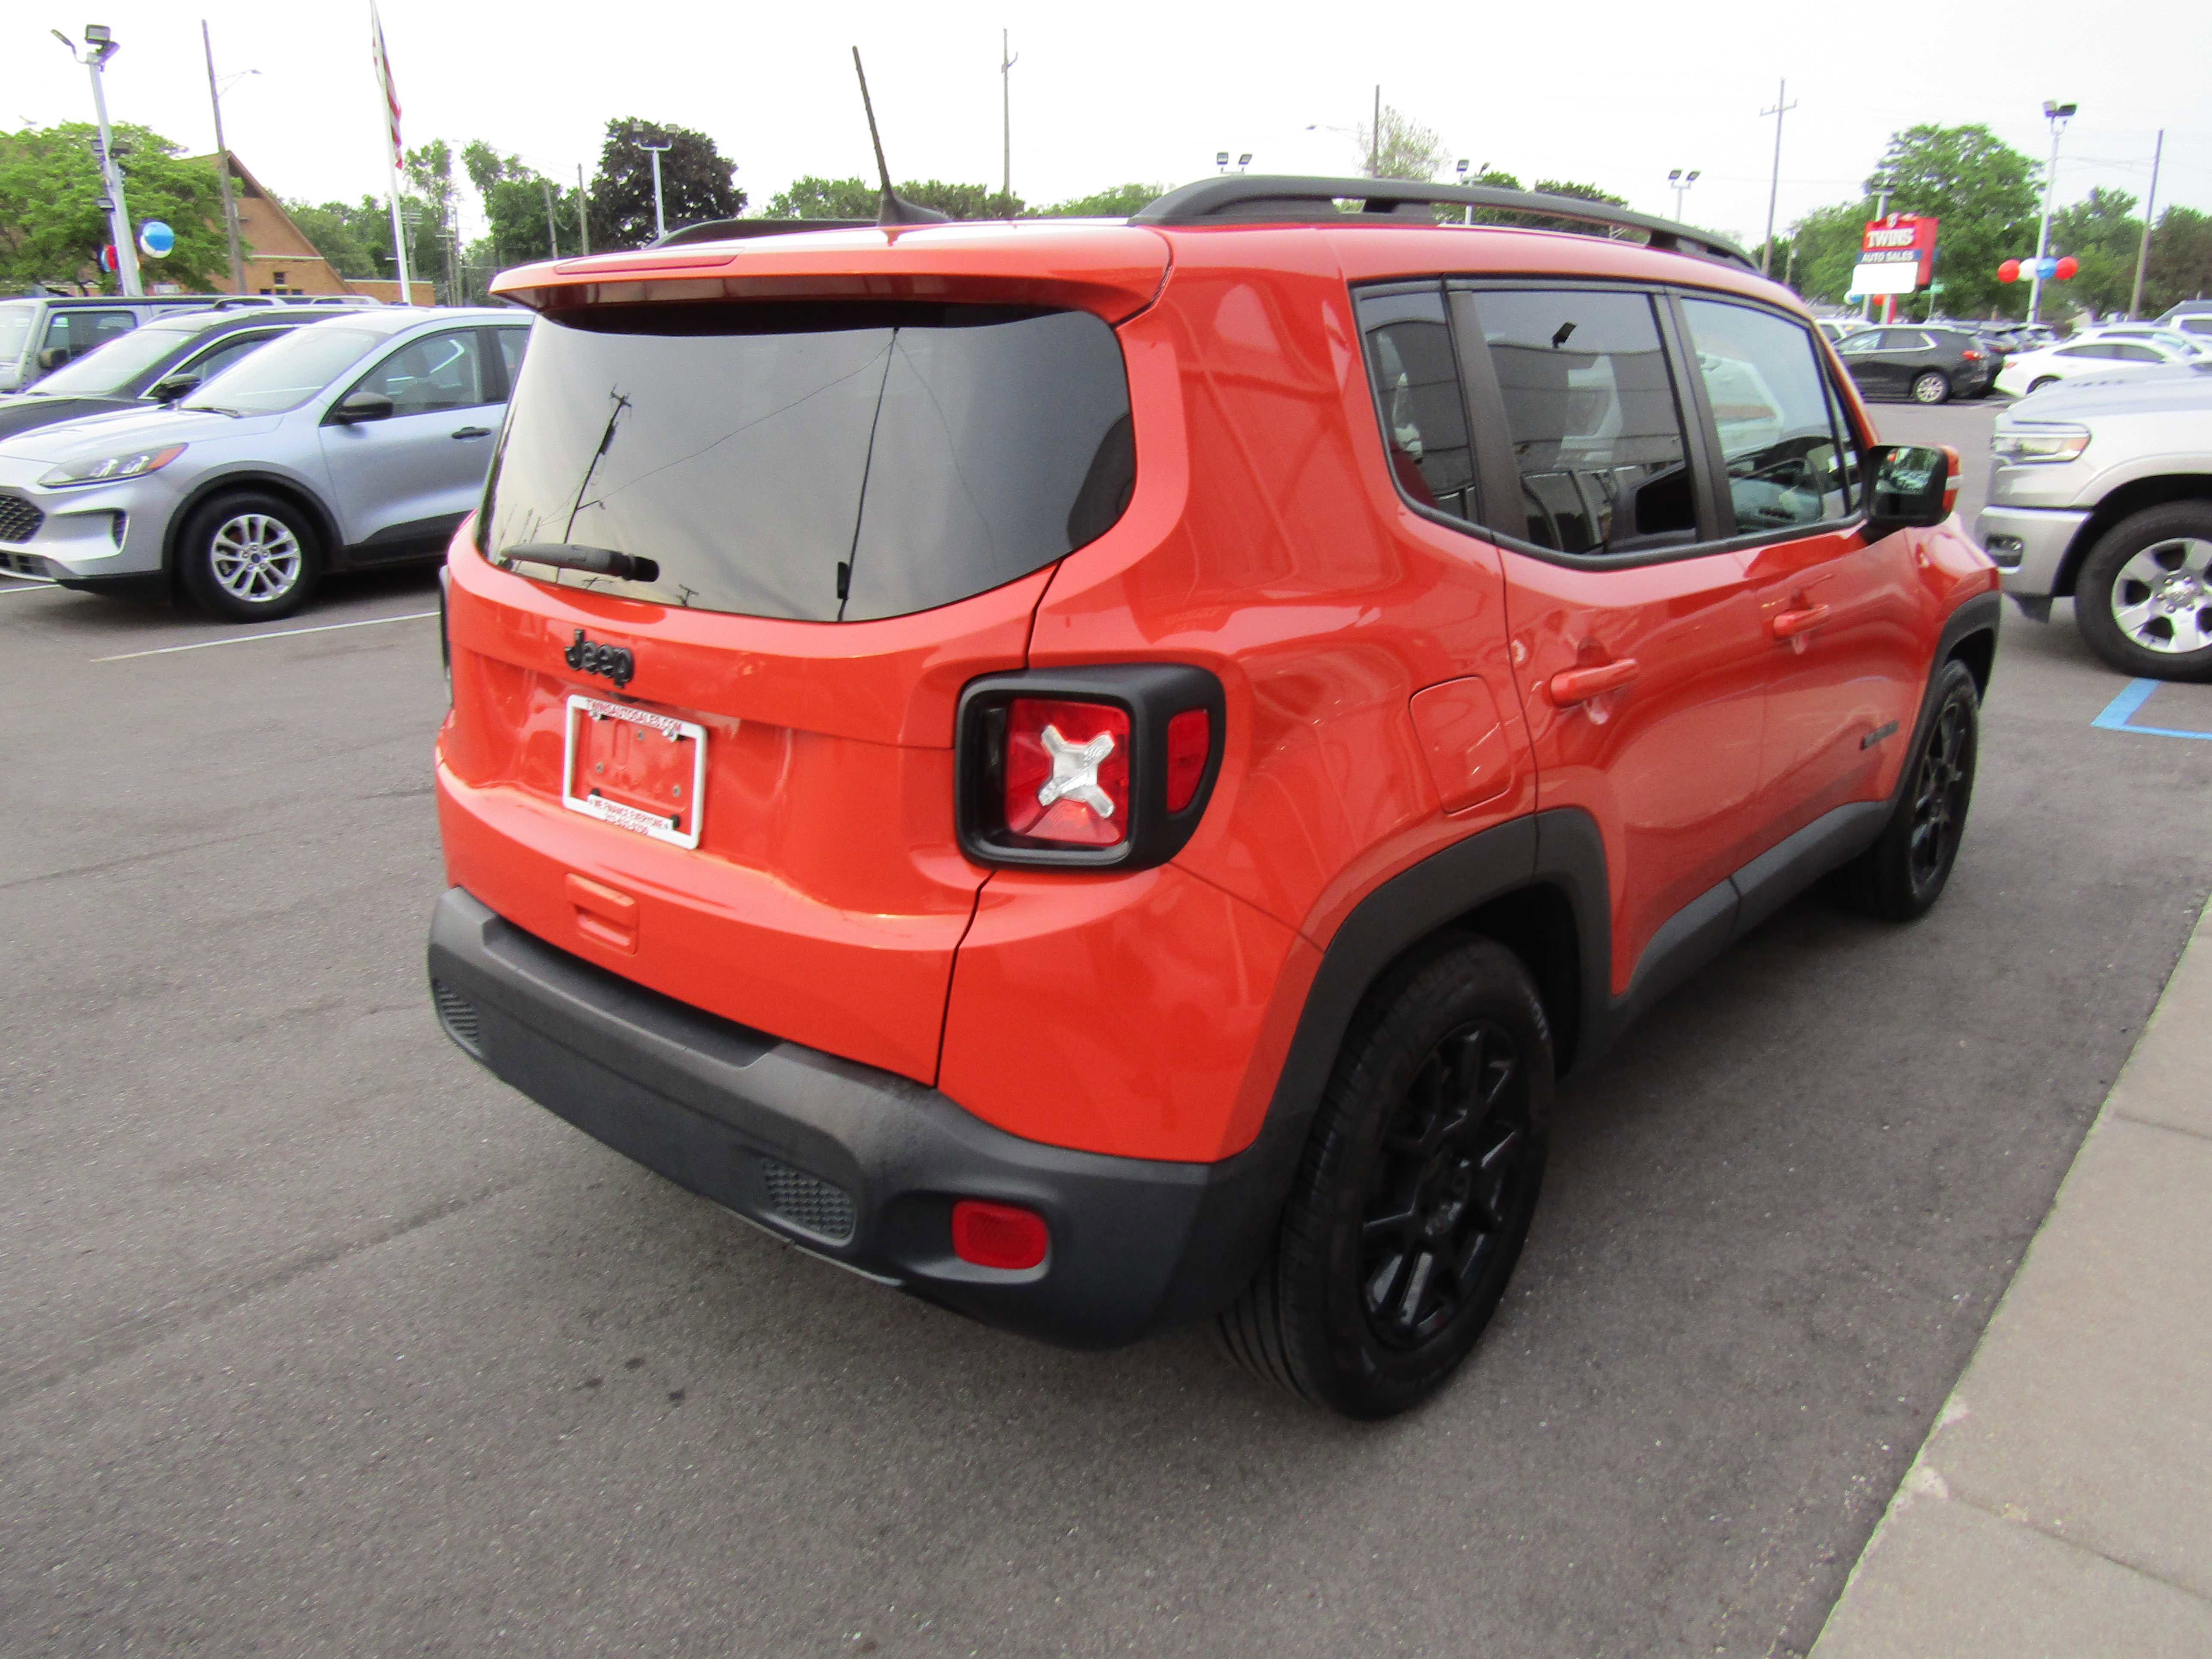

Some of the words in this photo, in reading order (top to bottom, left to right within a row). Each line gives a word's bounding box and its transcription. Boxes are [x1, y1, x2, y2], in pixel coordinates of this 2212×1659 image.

[1867, 227, 1915, 248] TWINS
[1861, 251, 1885, 263] AUTO
[1885, 249, 1914, 262] SALES
[564, 629, 634, 689] Jeep
